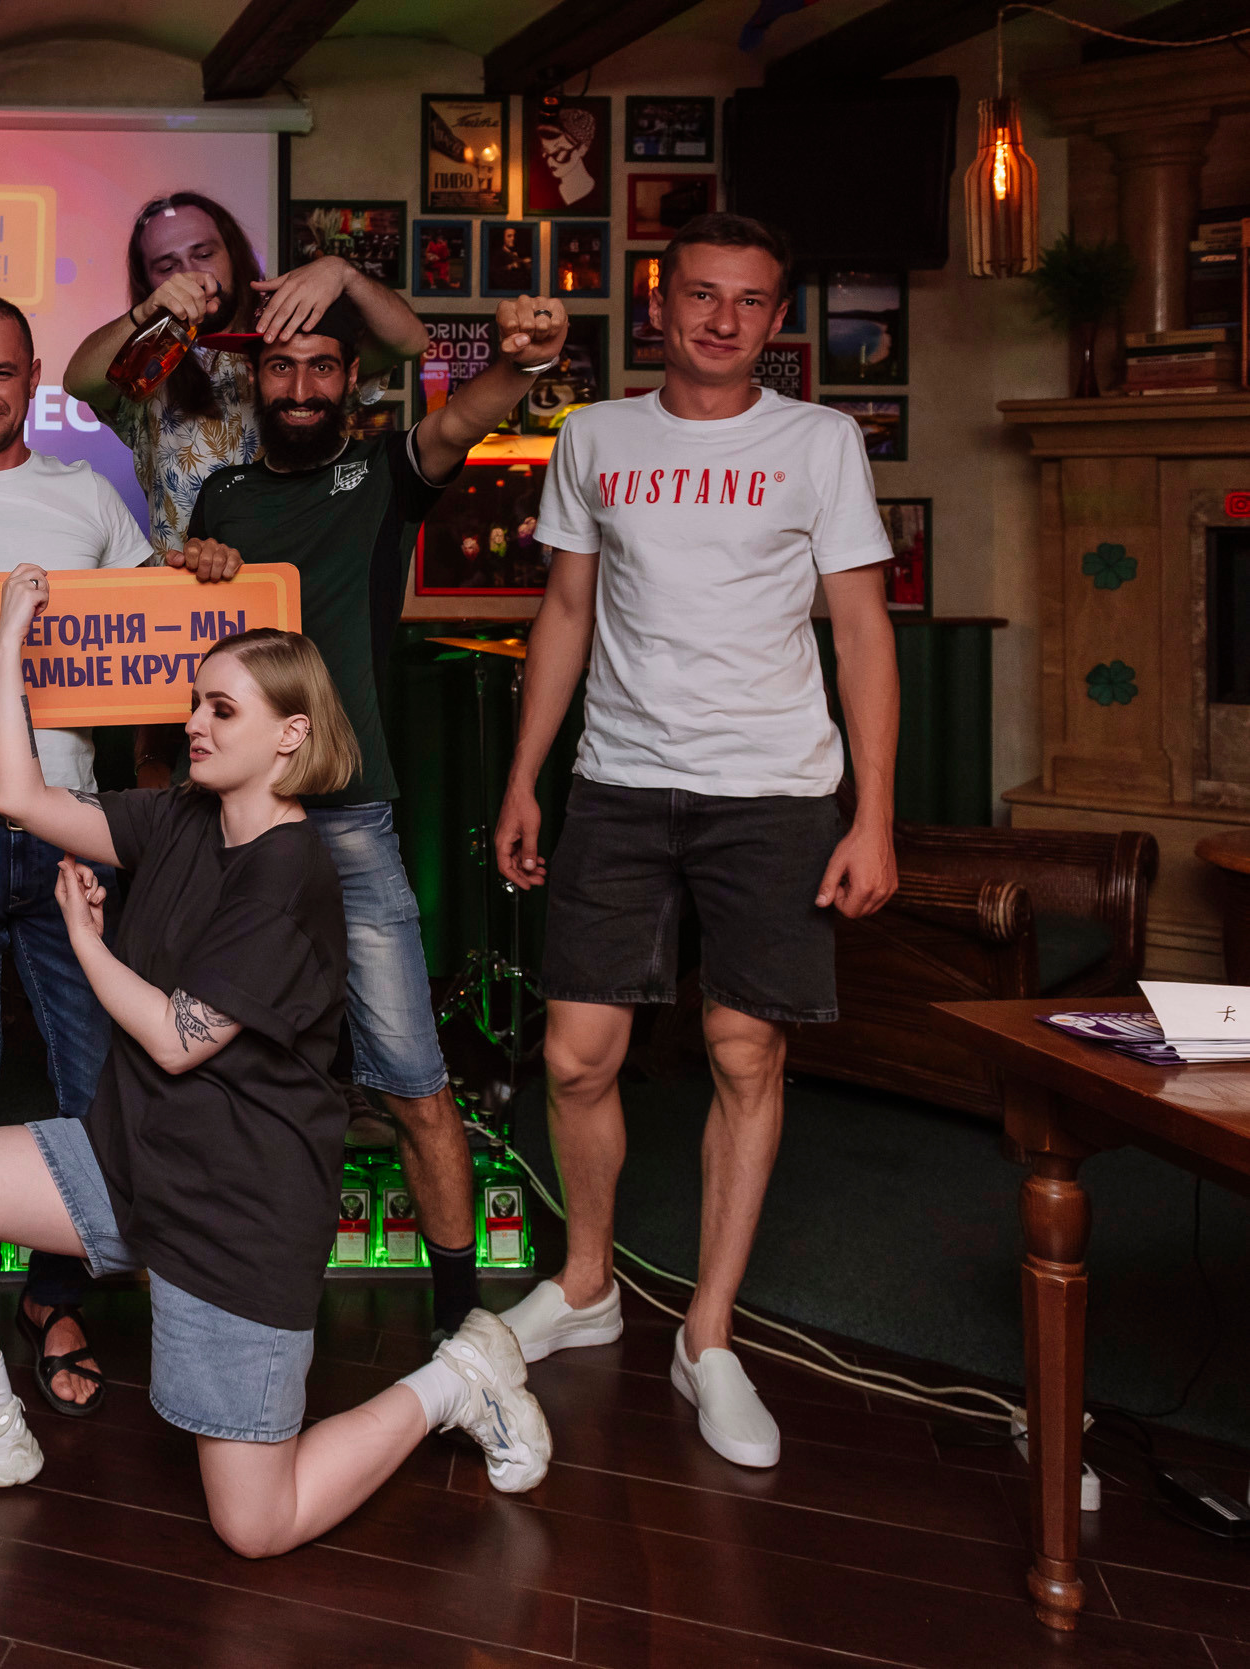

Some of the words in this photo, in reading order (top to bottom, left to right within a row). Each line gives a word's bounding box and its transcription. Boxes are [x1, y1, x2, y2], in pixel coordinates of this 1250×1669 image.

[434, 172, 473, 189] ПИВО
[424, 323, 490, 339] DRINK
[423, 341, 490, 360] GOOD
[758, 351, 799, 363] INK
[752, 363, 800, 376] OOD
[599, 468, 767, 508] MUSTANG
[22, 613, 146, 651] ЕГОДНЯ
[190, 610, 246, 642] МЫ
[21, 656, 113, 688] АМЫЕ
[121, 652, 207, 685] КРУТ
